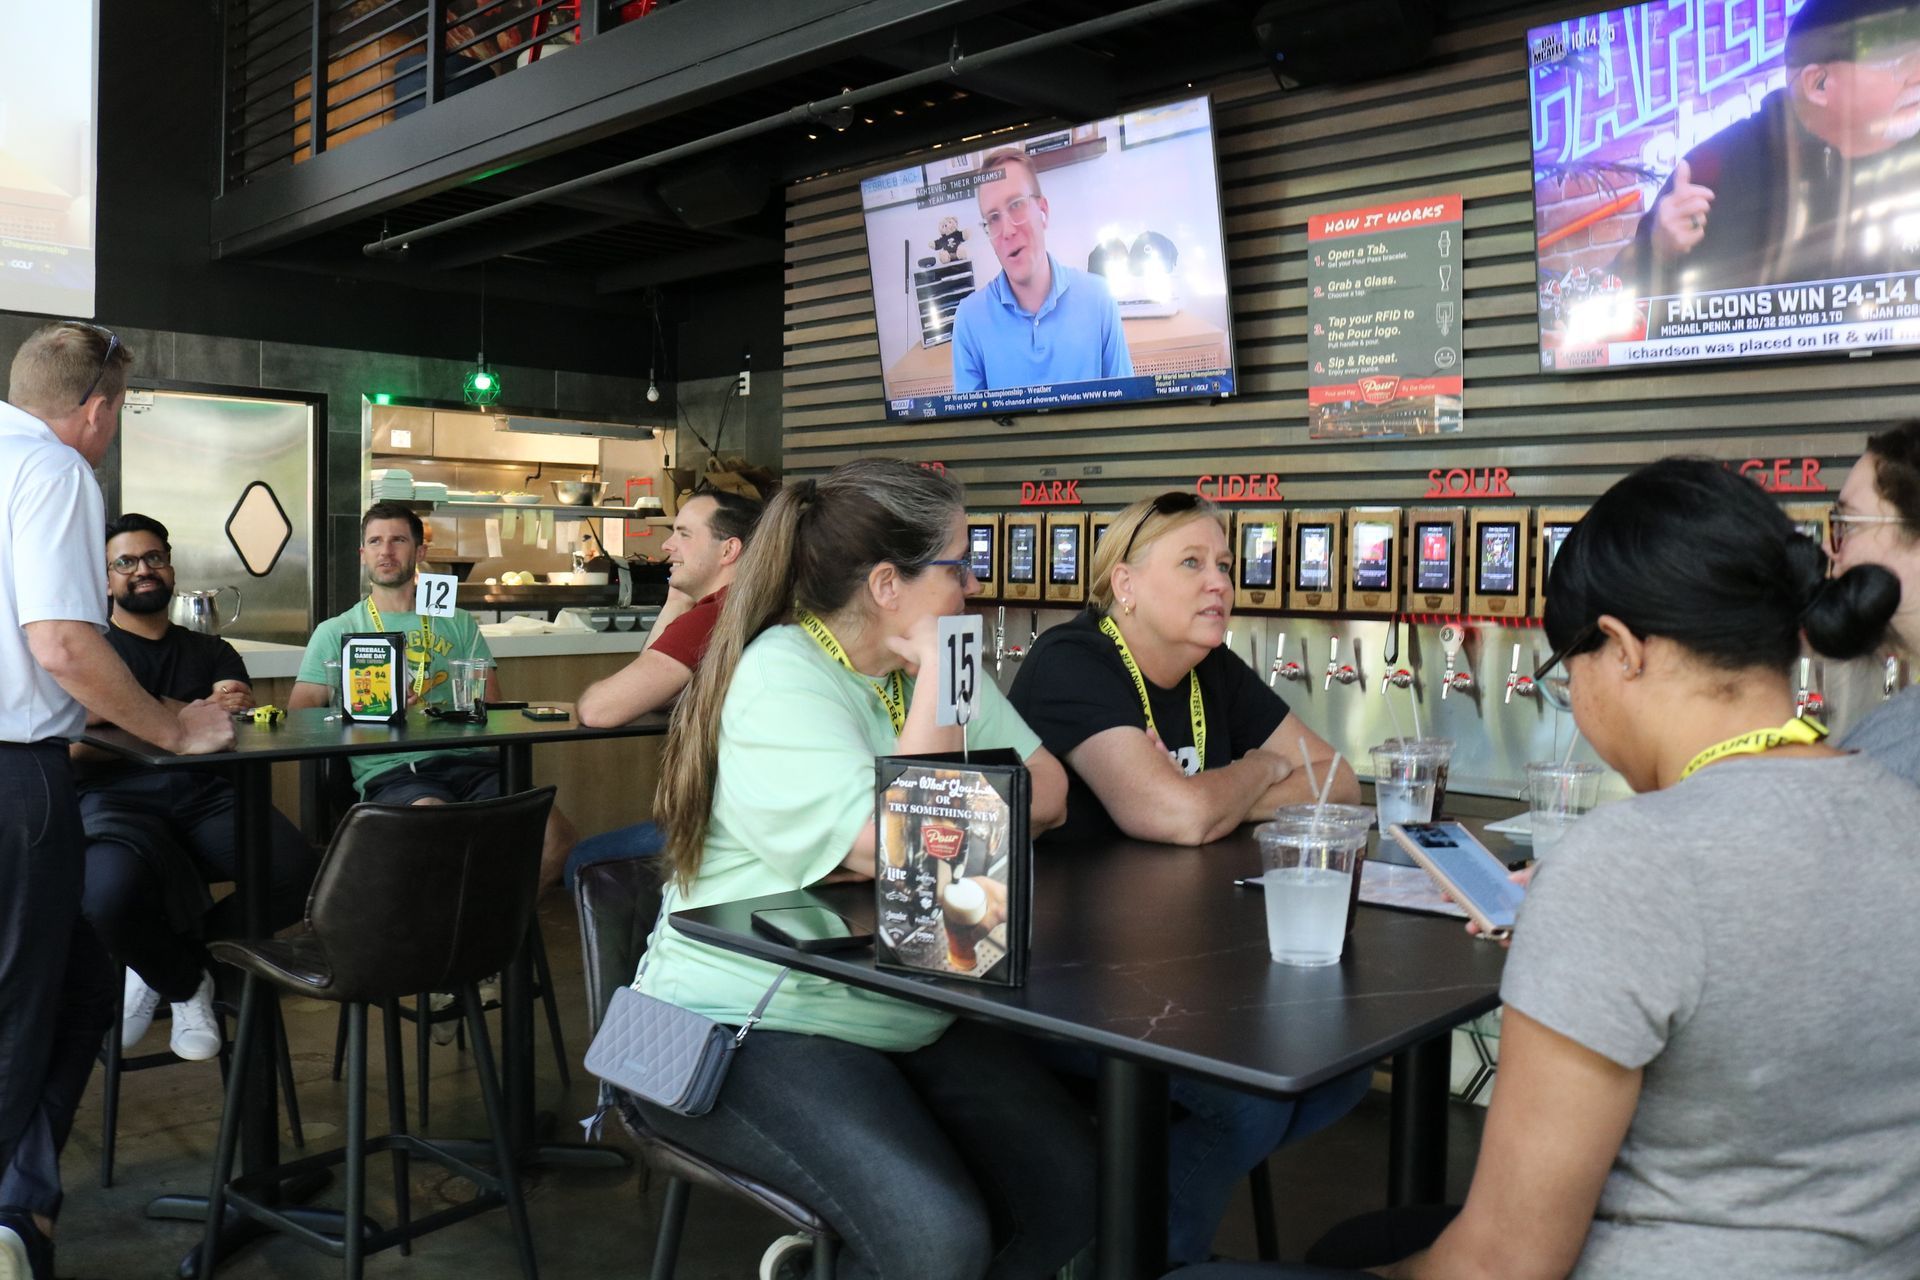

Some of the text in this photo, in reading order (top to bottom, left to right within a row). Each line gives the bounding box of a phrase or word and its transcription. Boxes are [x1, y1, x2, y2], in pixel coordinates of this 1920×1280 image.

[916, 171, 1002, 197] ACHIEVED THEIR DREAMS?
[928, 196, 944, 206] YEAH
[949, 192, 964, 202] MATT
[1325, 204, 1444, 234] HOW IT WORKS
[1314, 242, 1389, 267] 1. Open a Tab.
[1313, 275, 1397, 299] 2. Grab a Glass.
[1667, 291, 1772, 323] FALCONS
[1778, 286, 1825, 313] WIN
[1832, 278, 1907, 309] 24-14
[1328, 316, 1347, 328] Tap
[1348, 313, 1373, 327] your
[1375, 309, 1401, 322] RFID
[1403, 309, 1415, 320] to
[1661, 322, 1701, 337] MICHAEL
[1702, 319, 1731, 333] PENIX
[1732, 318, 1744, 331] JR
[1746, 315, 1776, 329] 20/32
[1798, 311, 1820, 325] YDS
[1821, 311, 1829, 323] 1
[1829, 310, 1843, 322] TD
[1328, 325, 1401, 341] the Pour logo.
[1627, 343, 1700, 360] ichardson
[1705, 342, 1734, 354] was
[1739, 335, 1792, 355] placed
[1797, 335, 1817, 347] on
[1823, 332, 1840, 345] IR
[1846, 330, 1860, 343] &
[1865, 327, 1893, 342] will
[1314, 352, 1398, 374] 4. Sip & Repeat.
[952, 393, 968, 401] World
[983, 388, 1024, 400] Championship
[1028, 386, 1052, 395] Weather
[992, 400, 1005, 408] 10%
[1005, 397, 1026, 407] chance
[1026, 397, 1033, 405] of
[1033, 395, 1060, 405] showers,
[1059, 392, 1082, 402] Winds:
[1082, 391, 1101, 400] WNW
[1107, 388, 1123, 398] mph
[1156, 387, 1168, 395] THU
[1362, 380, 1396, 393] Pour
[1196, 472, 1283, 502] CIDER
[1424, 466, 1515, 498] SOUR
[1738, 458, 1827, 493] GER
[1021, 479, 1081, 504] DARK
[425, 580, 450, 610] 12
[374, 671, 387, 679] $4
[947, 632, 975, 706] 15
[1191, 671, 1202, 718] UNTEER
[919, 775, 950, 791] What
[948, 777, 974, 798] You
[935, 794, 951, 805] OR
[888, 802, 1000, 822] TRY SOMETHING NEW
[927, 829, 959, 843] Pour
[887, 866, 907, 881] Lite
